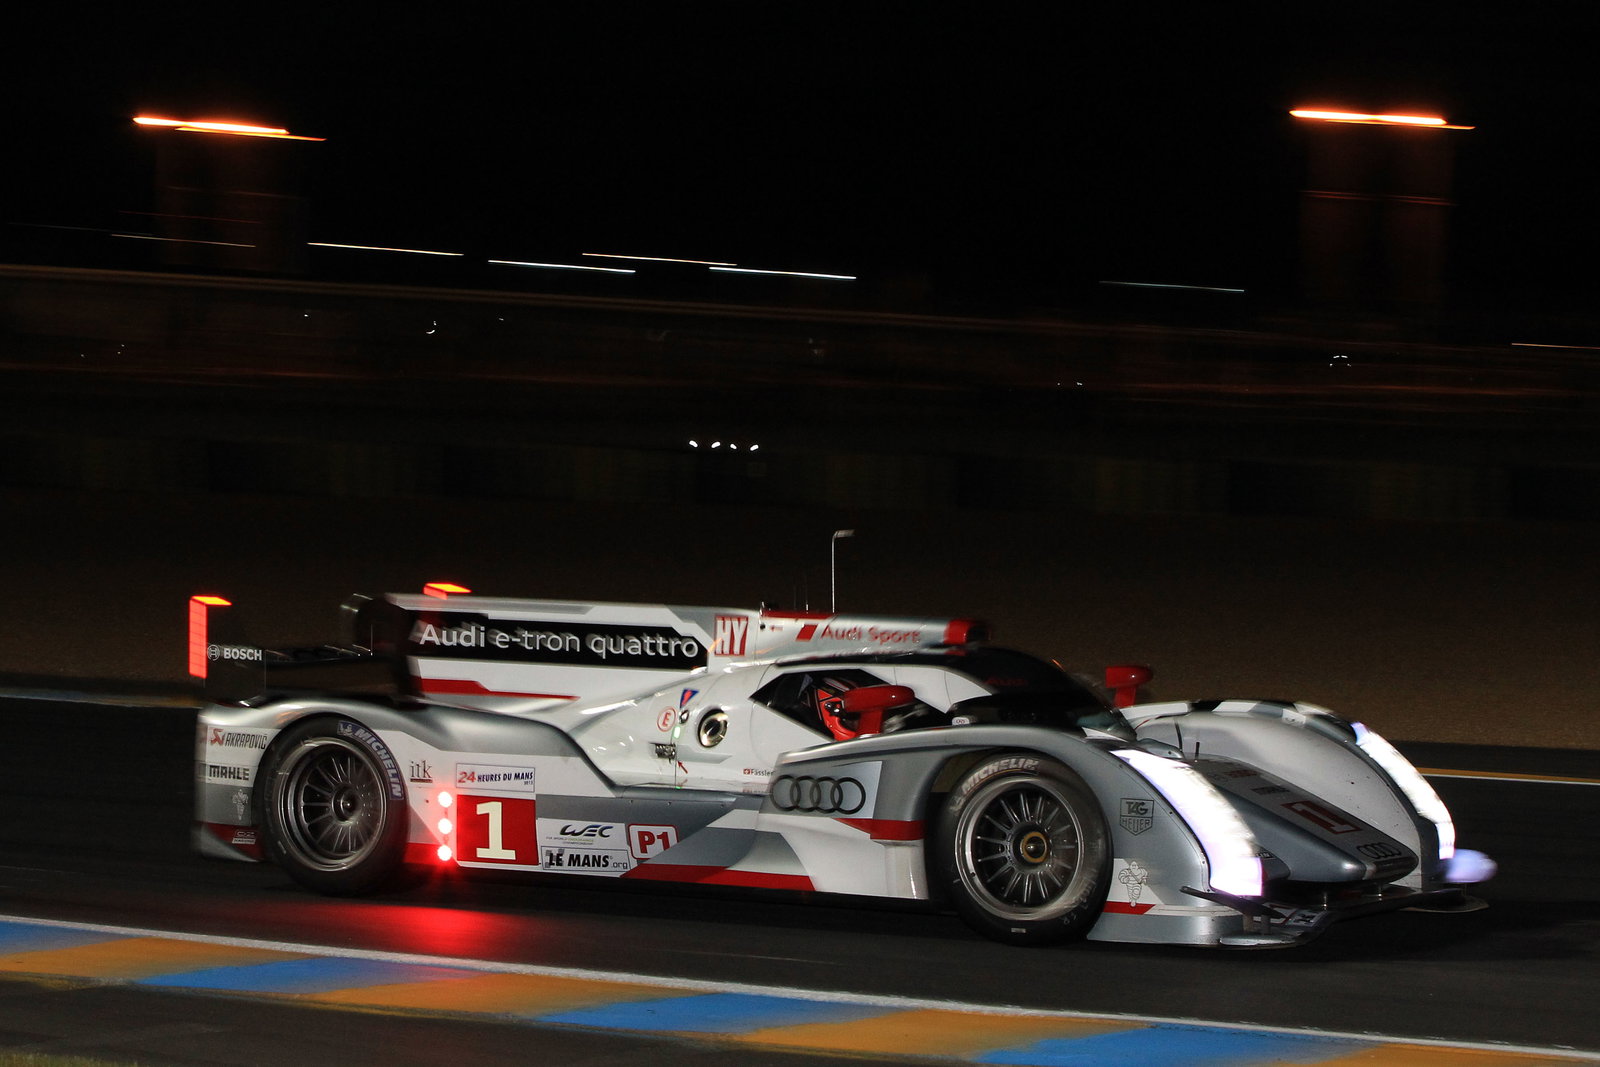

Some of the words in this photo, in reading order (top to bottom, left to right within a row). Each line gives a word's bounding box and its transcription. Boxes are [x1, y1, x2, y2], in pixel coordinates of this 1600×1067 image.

[420, 624, 485, 648] Audi
[495, 631, 580, 652] e-tron
[590, 637, 698, 659] quattro
[716, 617, 748, 655] HY
[820, 624, 862, 641] Audi
[868, 626, 921, 646] Sport
[223, 648, 262, 661] BOSCH
[662, 712, 671, 727] E
[354, 728, 402, 798] MICHELIN
[209, 765, 250, 781] MAHLE
[458, 771, 476, 783] 24
[477, 773, 501, 782] HEURES
[503, 773, 512, 781] DU
[513, 772, 533, 780] MANS
[962, 758, 1039, 795] MICHELIN
[476, 801, 516, 860] 1
[560, 824, 613, 837] WEC
[1122, 817, 1151, 832] HEUER
[637, 831, 670, 853] P1
[567, 853, 610, 868] MANS
